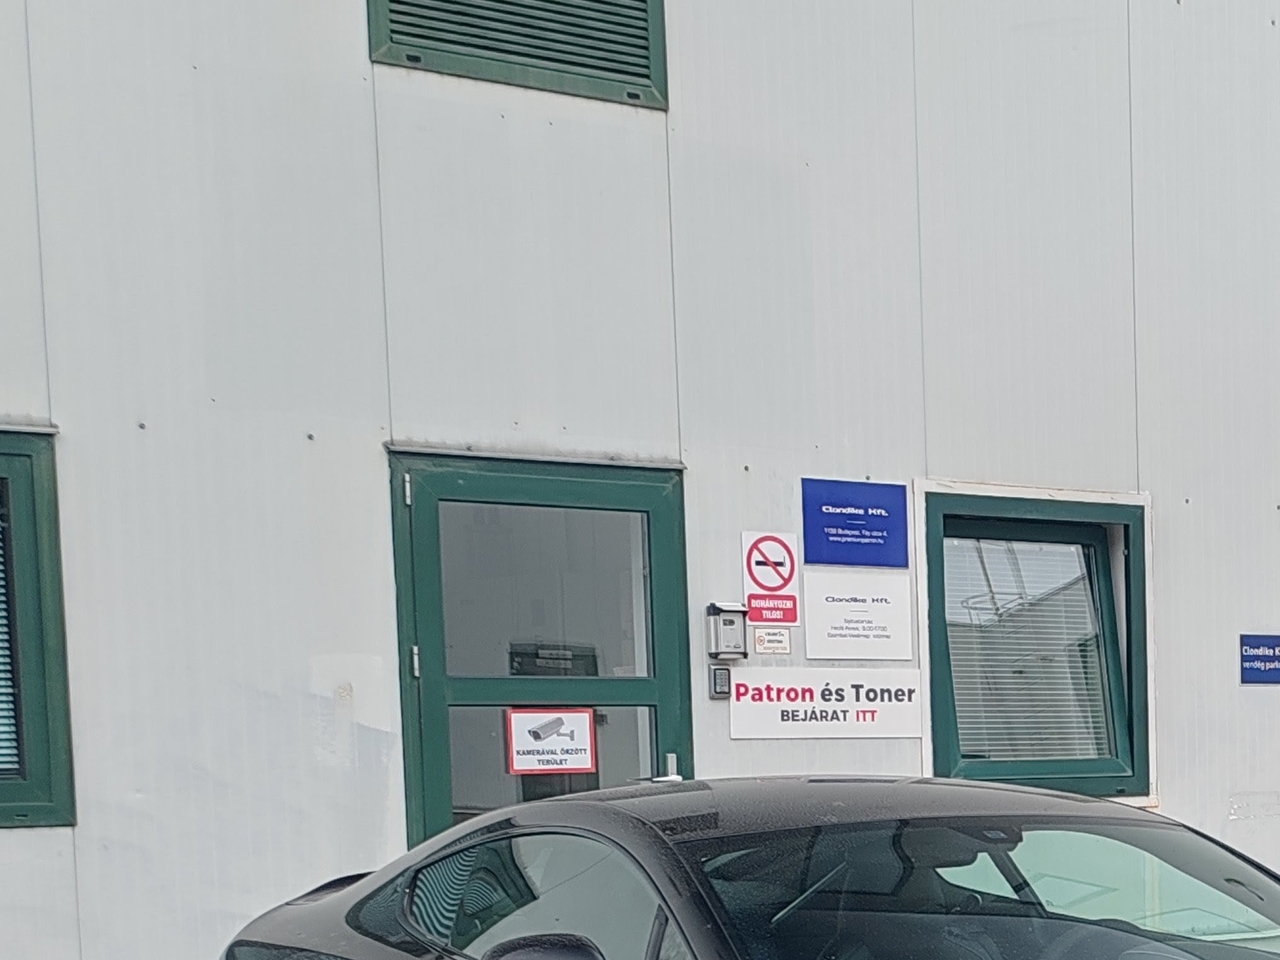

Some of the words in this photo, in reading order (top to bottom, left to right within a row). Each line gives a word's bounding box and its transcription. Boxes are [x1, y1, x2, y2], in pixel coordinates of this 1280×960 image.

[821, 505, 865, 515] Clondike
[867, 507, 889, 517] Kft.
[751, 597, 794, 609] DOHÁNYOZNI
[825, 596, 867, 604] Clondike
[871, 597, 891, 605] Kft.
[762, 610, 784, 619] TILOS!
[734, 683, 815, 703] Patron
[820, 682, 845, 703] és
[850, 684, 916, 703] Toner
[780, 706, 849, 722] BEJÁRAT
[856, 710, 877, 722] ITT
[516, 747, 559, 757] KAMERÁVAL
[537, 758, 568, 766] TERÜLET
